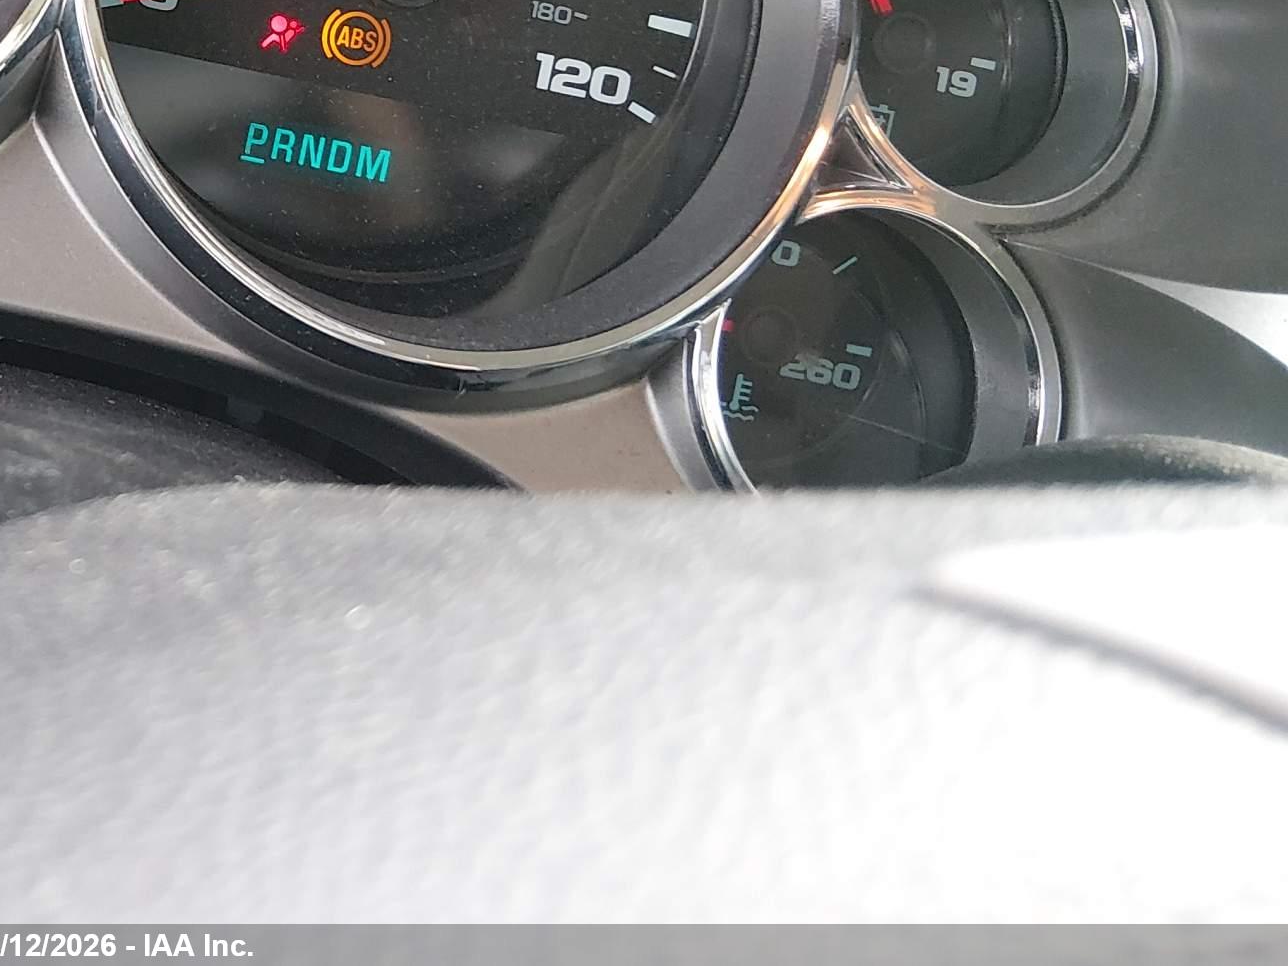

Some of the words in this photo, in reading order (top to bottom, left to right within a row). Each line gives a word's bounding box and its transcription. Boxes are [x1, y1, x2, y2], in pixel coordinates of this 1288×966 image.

[530, 0, 572, 26] 180
[337, 25, 378, 55] ABS
[535, 52, 632, 106] 120
[935, 65, 978, 99] 19
[242, 121, 392, 183] PRNDM
[779, 353, 861, 391] 260
